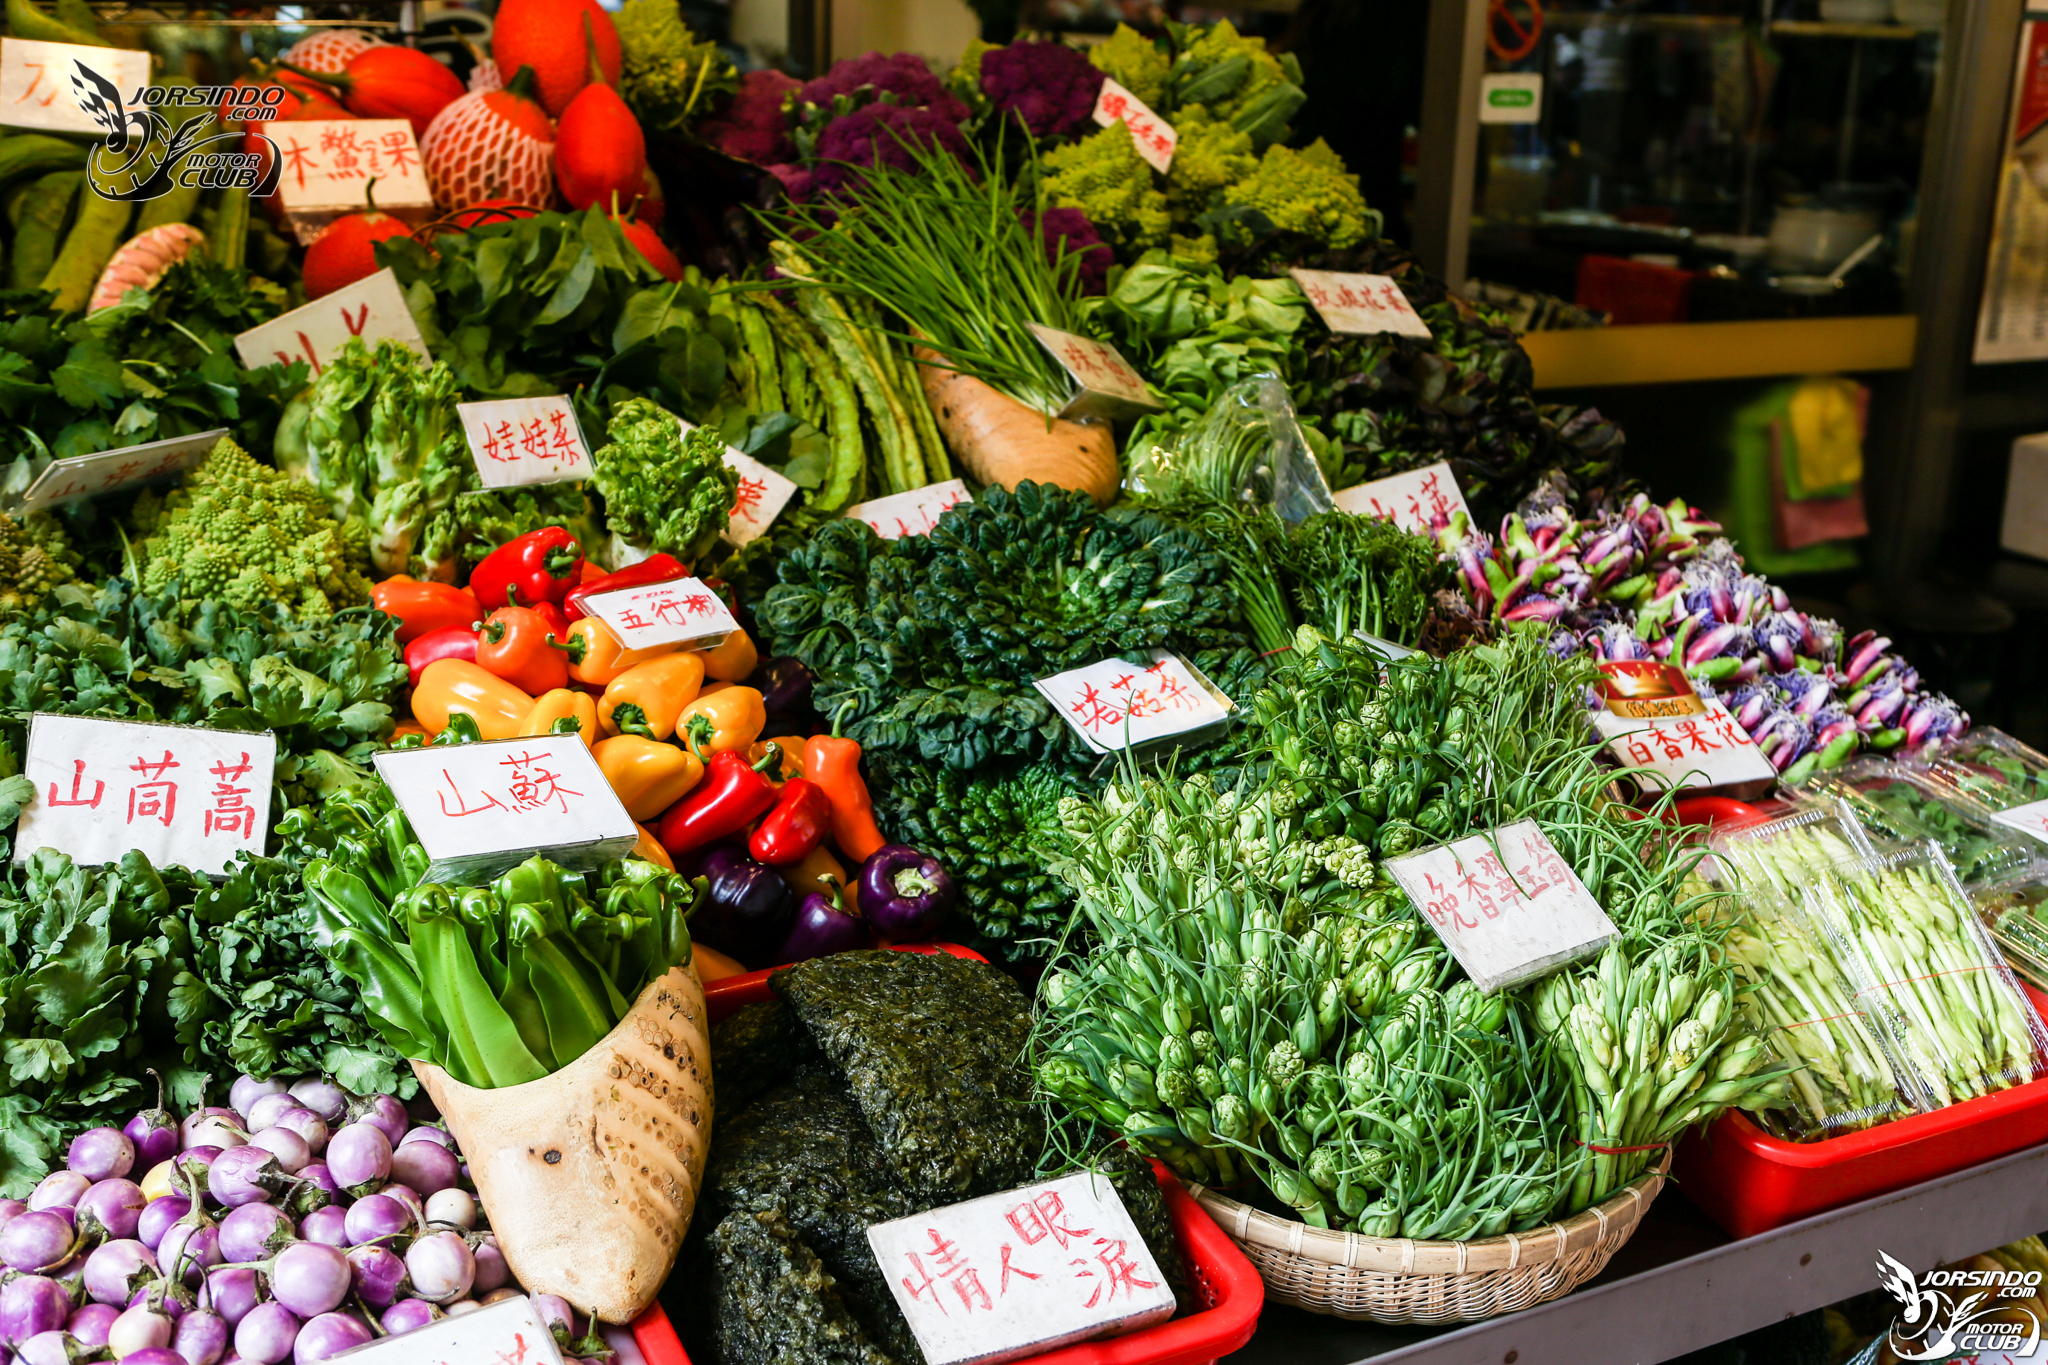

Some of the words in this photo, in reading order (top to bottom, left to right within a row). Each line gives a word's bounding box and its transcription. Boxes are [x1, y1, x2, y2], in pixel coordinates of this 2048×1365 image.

[482, 408, 581, 467] 娃娃菜
[1620, 706, 1752, 766] 百香果花
[47, 749, 256, 840] 山茼蒿
[436, 750, 584, 817] 山蘇
[901, 1190, 1161, 1317] 情人眼淚
